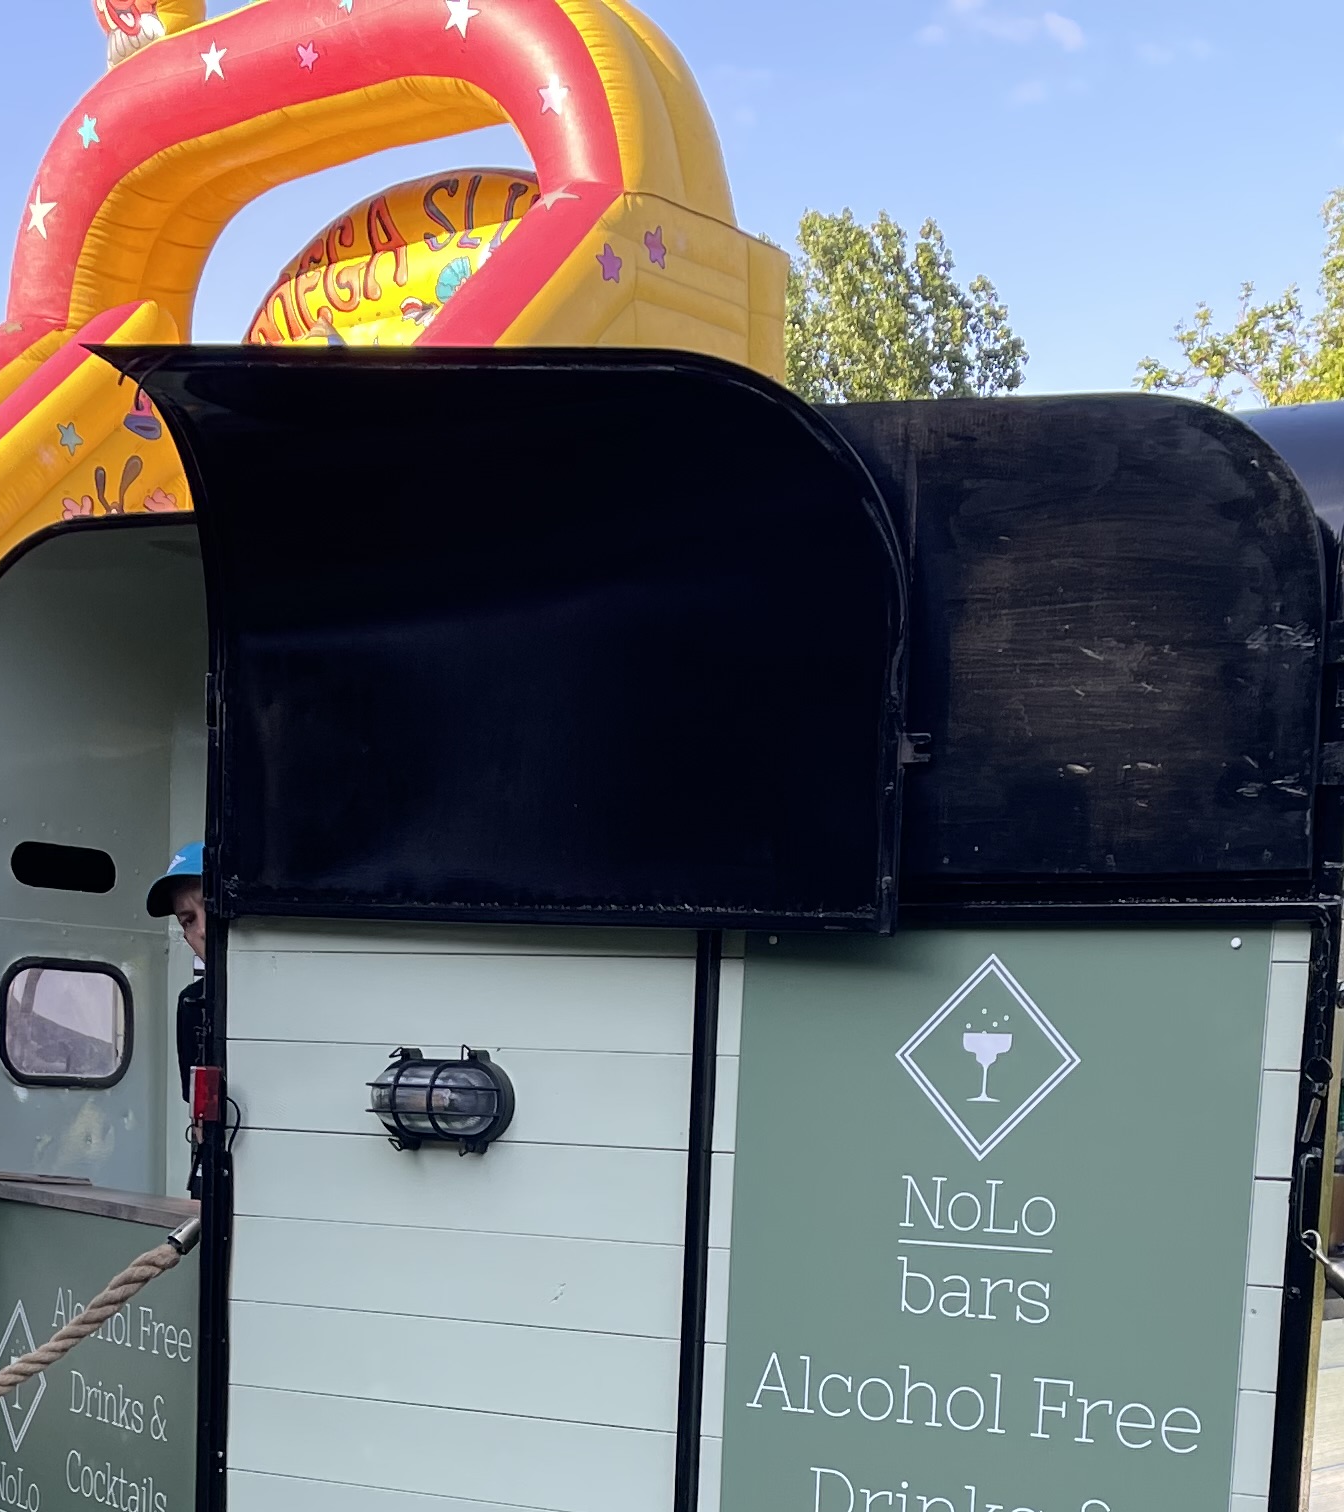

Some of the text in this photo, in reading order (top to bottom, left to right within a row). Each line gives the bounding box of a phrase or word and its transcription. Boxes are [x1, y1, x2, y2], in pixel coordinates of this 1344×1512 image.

[248, 174, 542, 346] MEGA SLI
[899, 1175, 1056, 1235] NoLo
[897, 1256, 1050, 1324] bars
[138, 1307, 192, 1362] Free
[70, 1370, 168, 1442] Drinks &
[746, 1352, 1202, 1453] Alcohol Free
